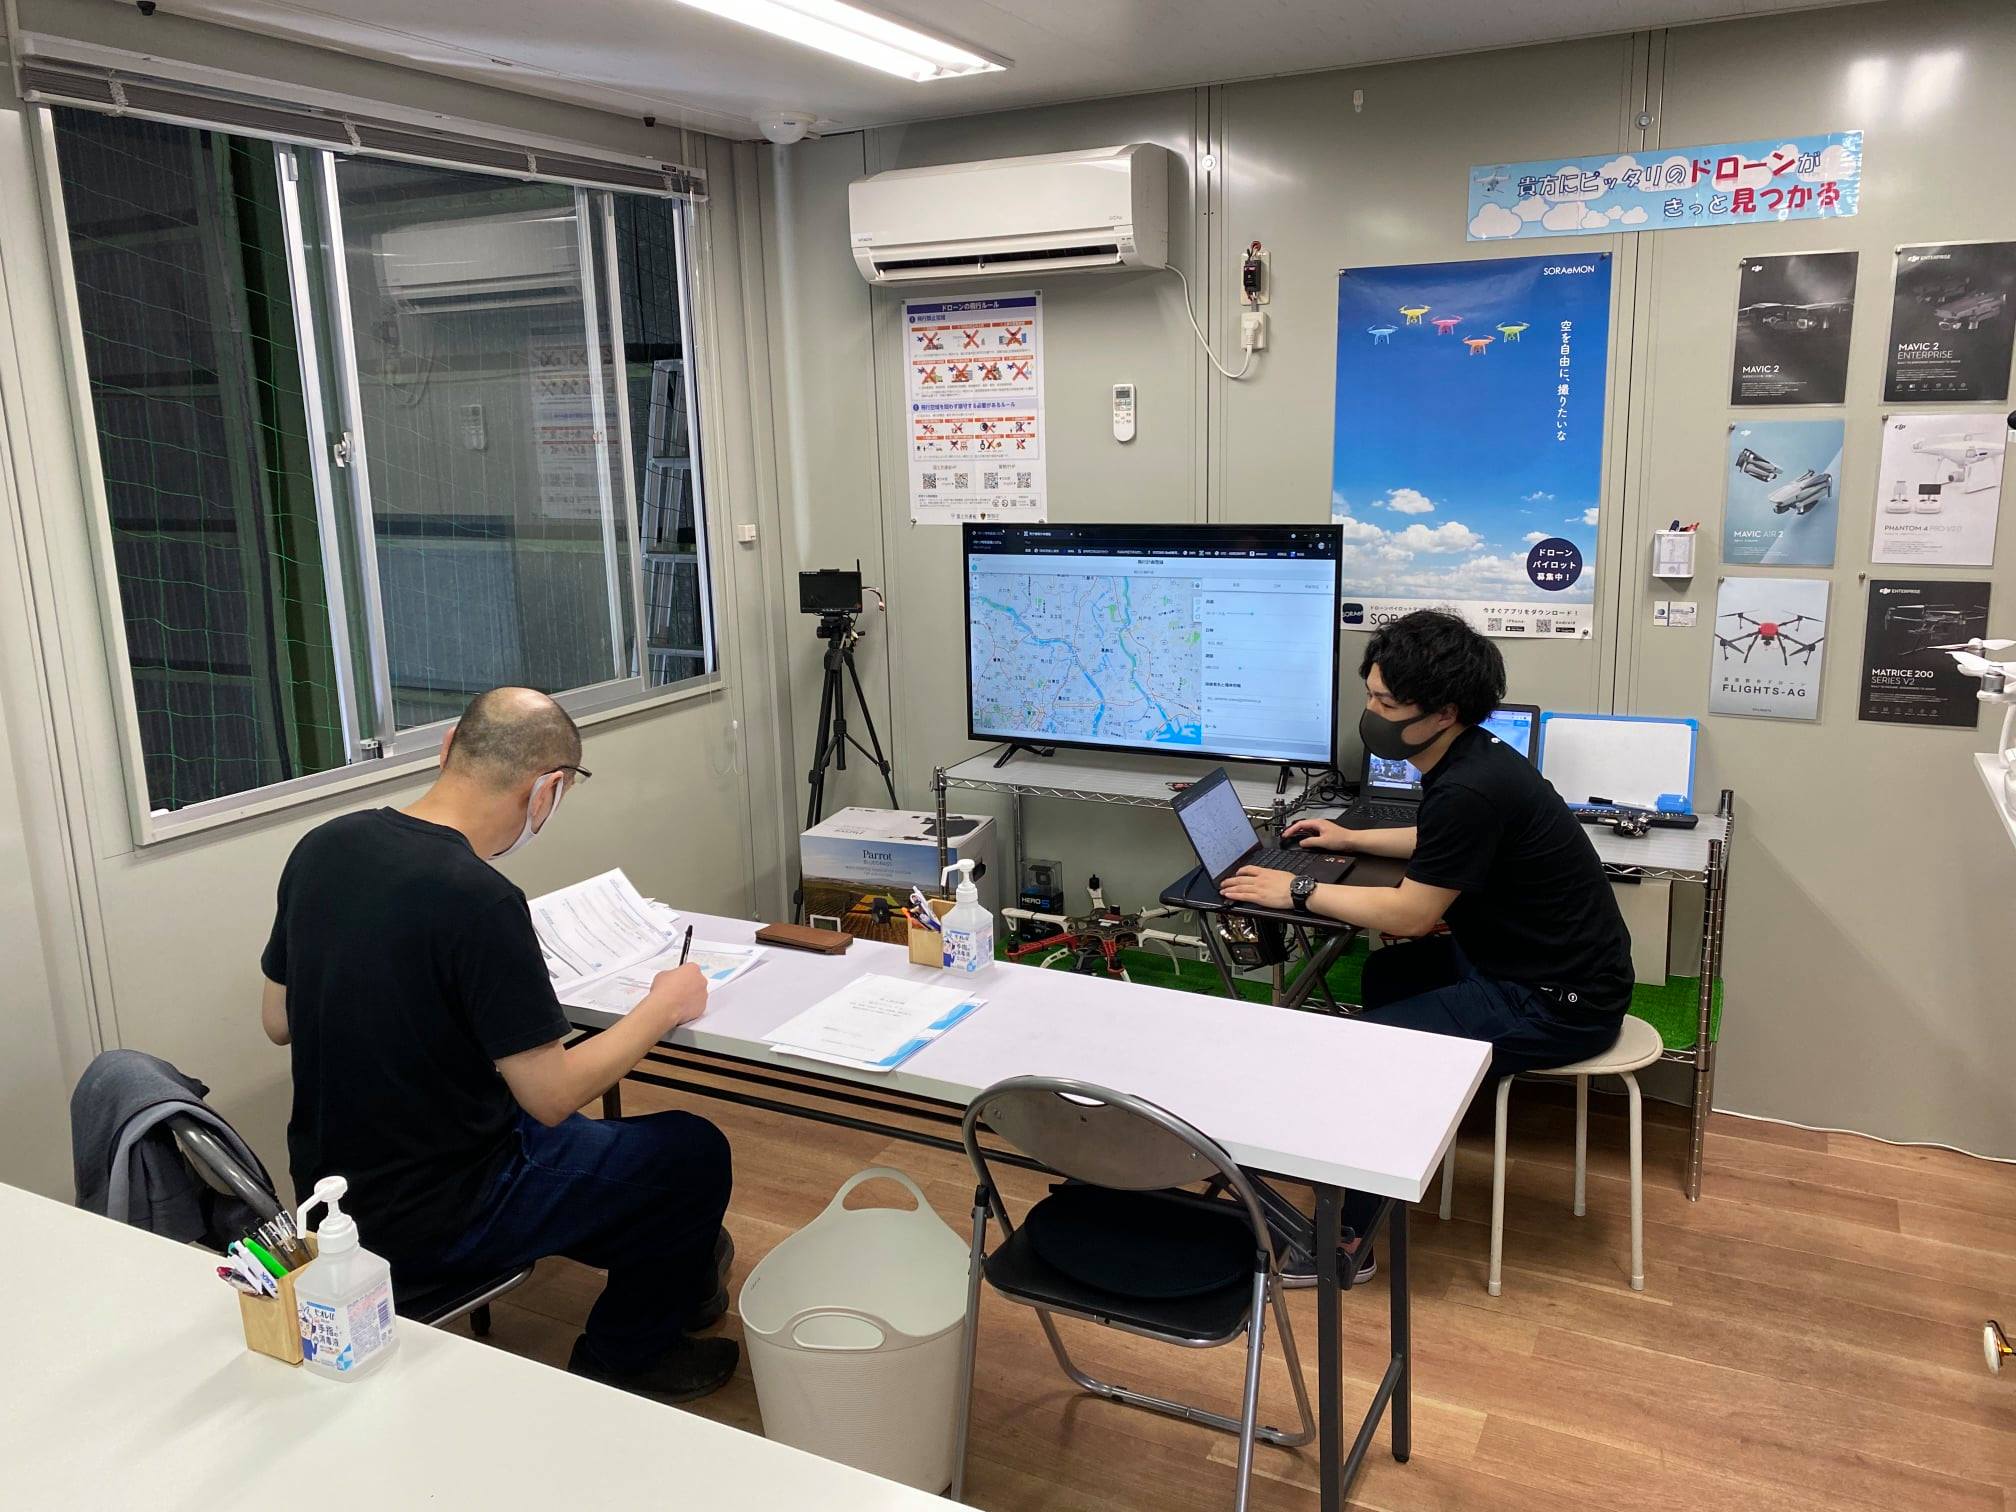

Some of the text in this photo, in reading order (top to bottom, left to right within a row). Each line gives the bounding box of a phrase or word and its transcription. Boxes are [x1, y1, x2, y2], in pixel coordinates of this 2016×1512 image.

[1518, 151, 1821, 197] 貴方にピッタリのドローンが
[1664, 182, 1840, 216] きっと見つかる
[1543, 265, 1595, 276] SORAeMON
[1897, 342, 1940, 351] MAVIC 2
[1897, 350, 1954, 361] ENTERPRISE
[1742, 364, 1780, 374] MAVIC 2
[1556, 319, 1572, 441] 空を自由に、撮りたいな
[1884, 524, 1922, 532] PHANTOM
[1734, 530, 1784, 538] MAVIC AIR 2
[1539, 547, 1574, 558] ドローン
[1532, 560, 1578, 571] パイロット
[1871, 668, 1934, 679] MATRICE 200
[1871, 676, 1915, 686] SERIES V2
[1722, 684, 1807, 698] FLIGHTS-AG
[863, 849, 893, 861] Parrot
